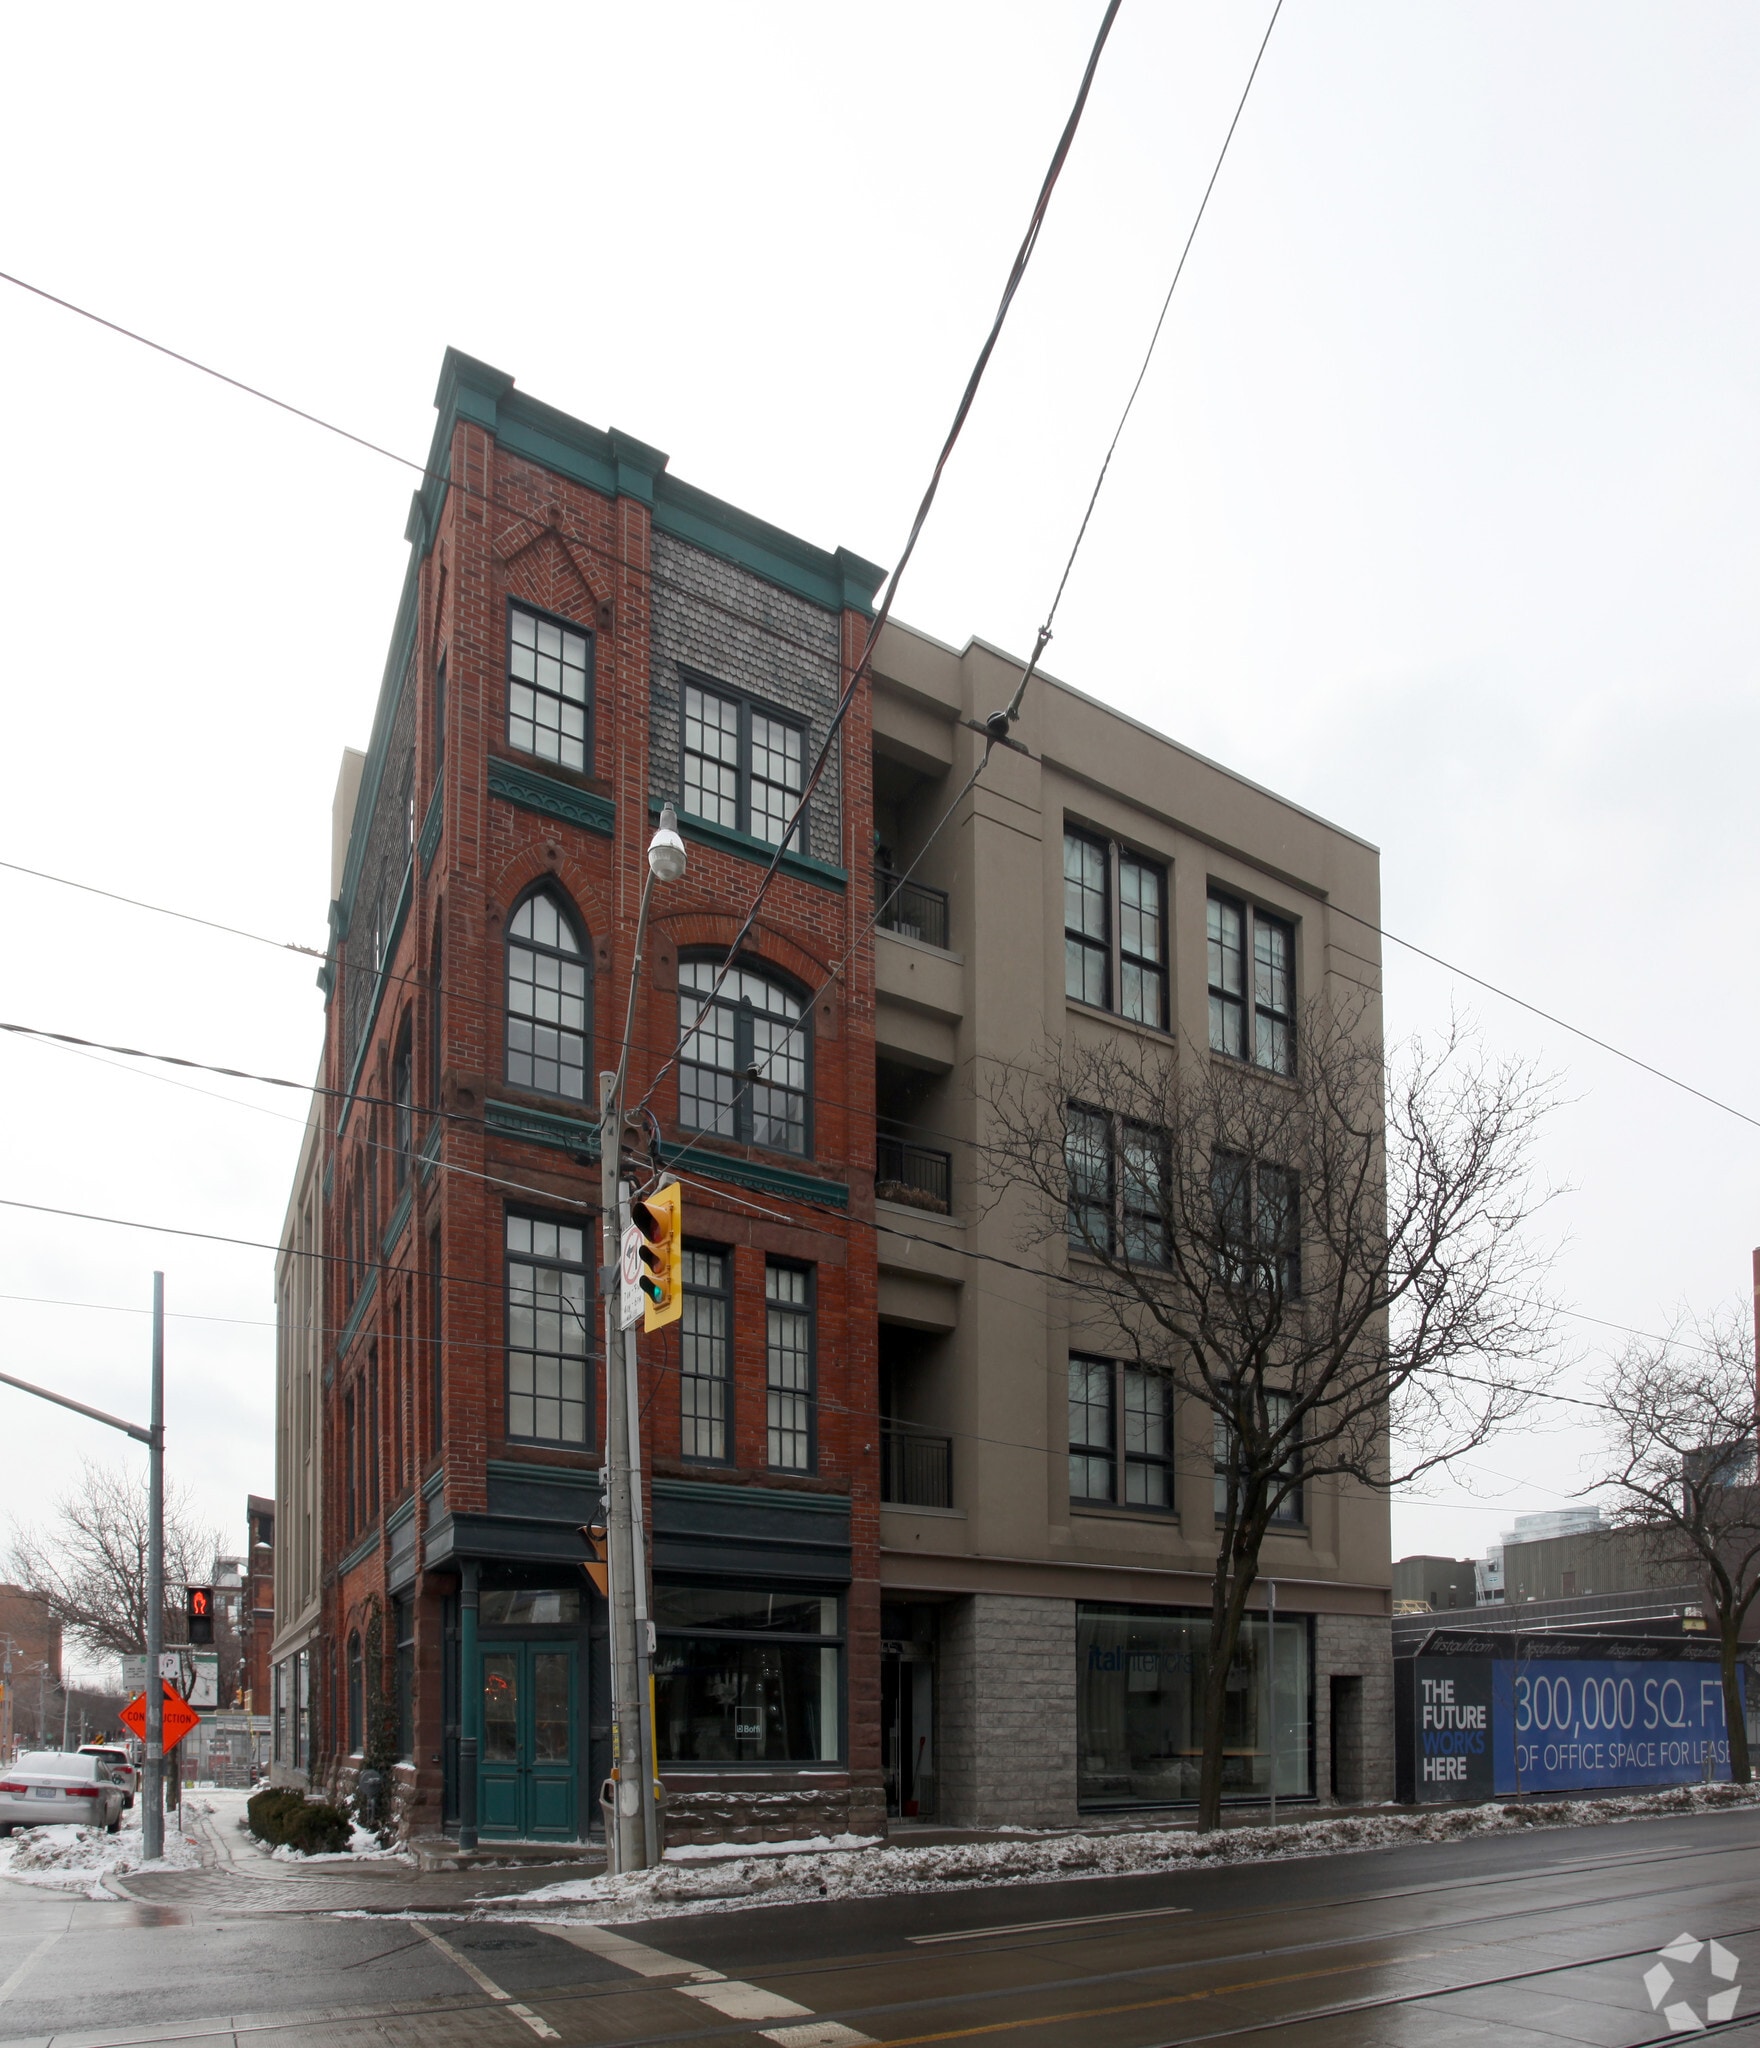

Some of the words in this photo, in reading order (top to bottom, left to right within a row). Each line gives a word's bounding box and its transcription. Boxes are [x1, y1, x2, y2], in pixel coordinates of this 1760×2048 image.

[1421, 1679, 1455, 1703] THE
[1422, 1705, 1487, 1730] FUTURE
[1515, 1675, 1635, 1740] 300,000
[1643, 1678, 1692, 1730] SQ.
[1421, 1730, 1486, 1755] WORKS
[1423, 1756, 1467, 1781] HERE
[1516, 1744, 1539, 1772] OF
[1543, 1743, 1605, 1771] OFFICE
[1608, 1742, 1656, 1769] SPACE
[1660, 1741, 1690, 1768] FOR
